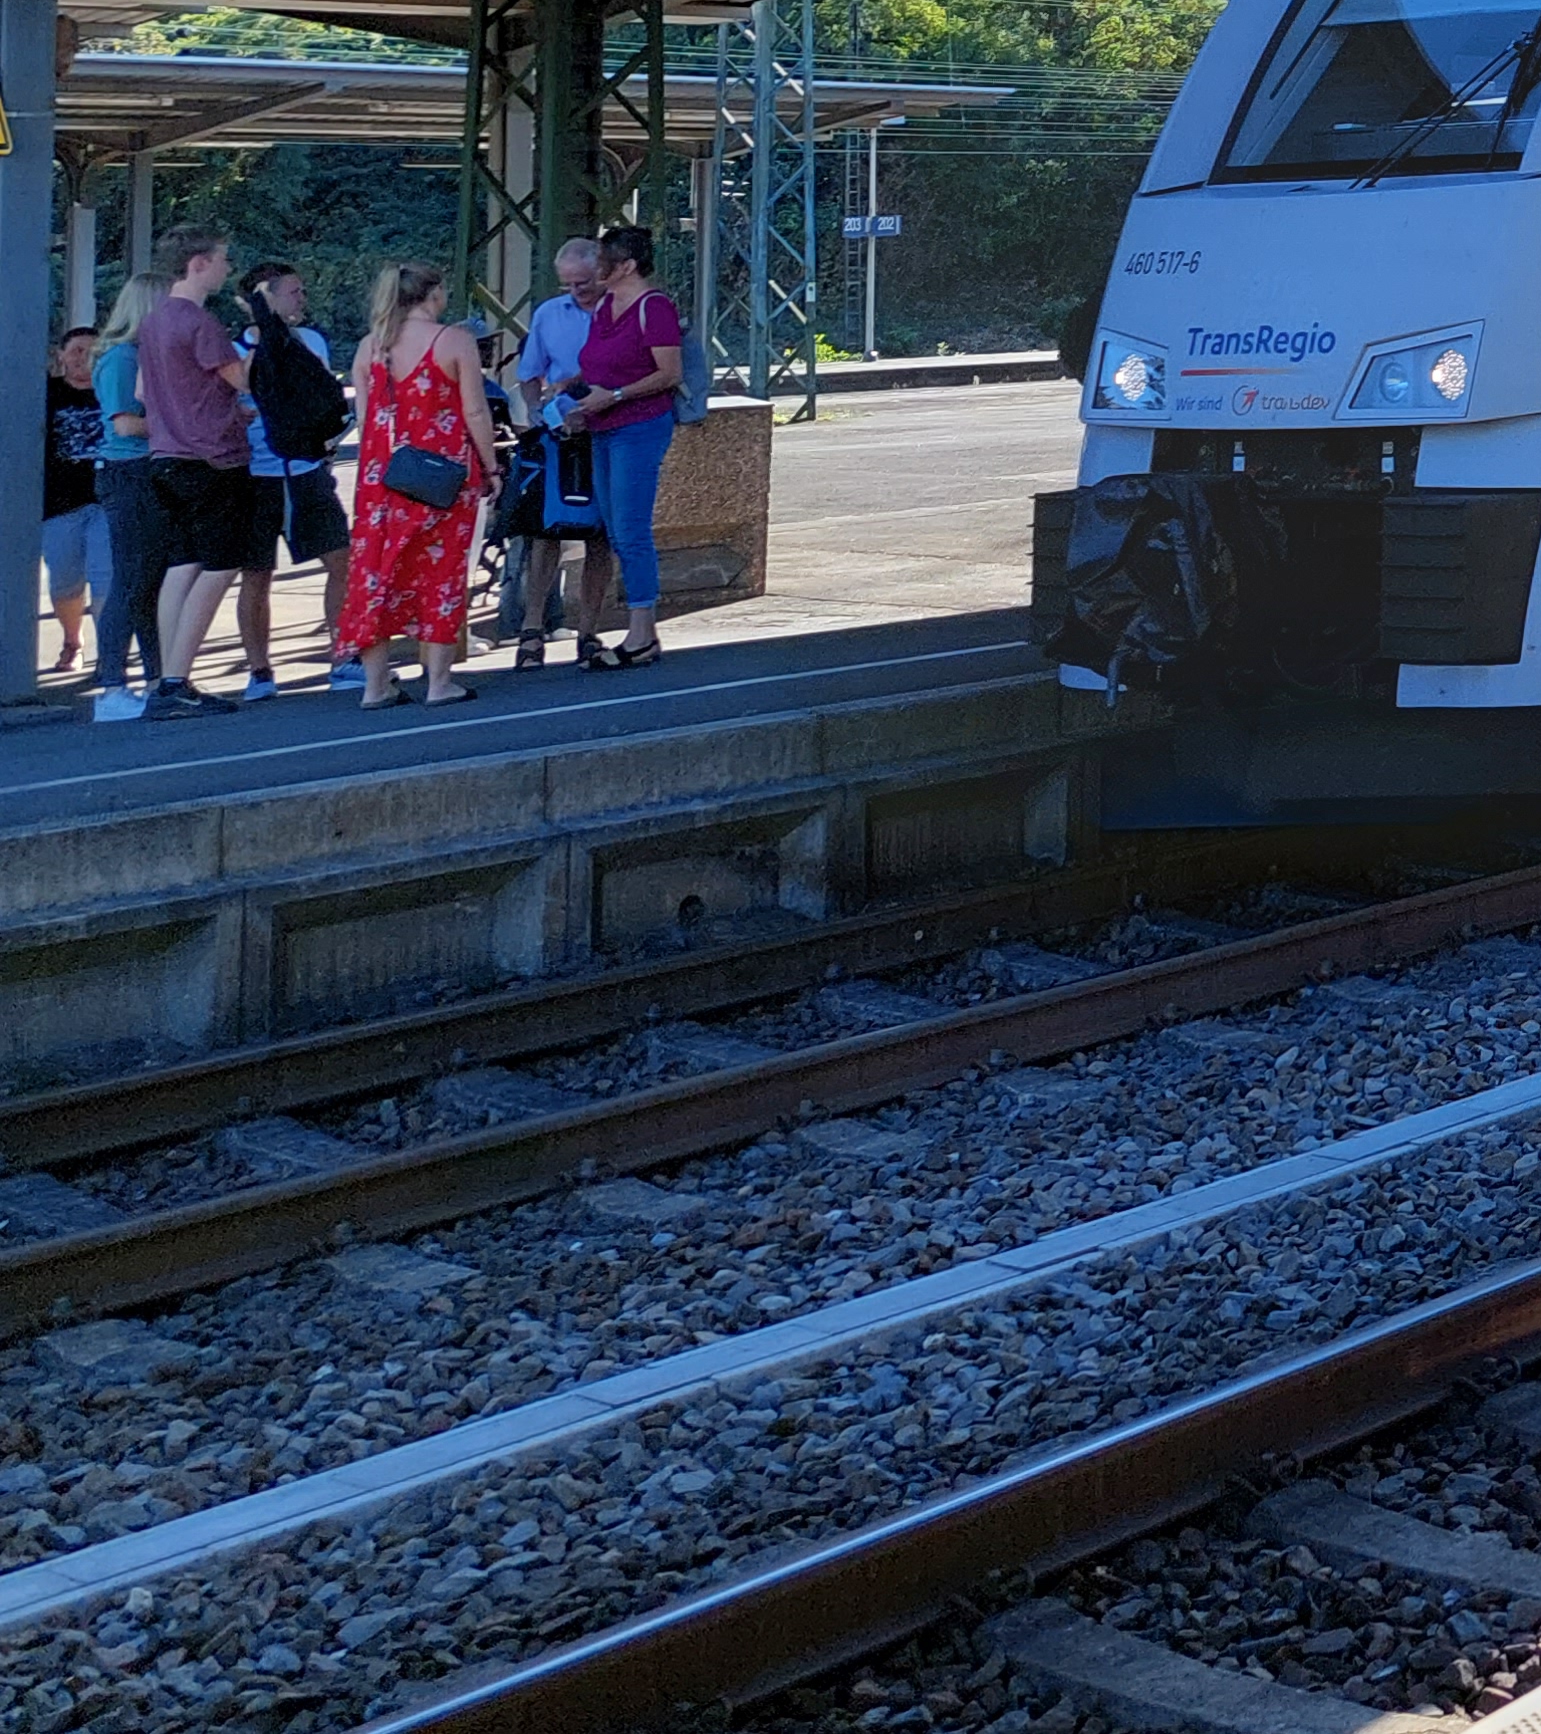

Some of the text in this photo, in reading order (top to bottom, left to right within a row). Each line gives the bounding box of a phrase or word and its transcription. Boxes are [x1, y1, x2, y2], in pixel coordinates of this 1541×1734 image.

[844, 217, 861, 232] 203
[877, 216, 895, 231] 202
[1124, 250, 1202, 276] 460 517-6
[1187, 321, 1336, 363] TransRegio
[1175, 396, 1195, 411] Wir
[1198, 394, 1224, 411] sind
